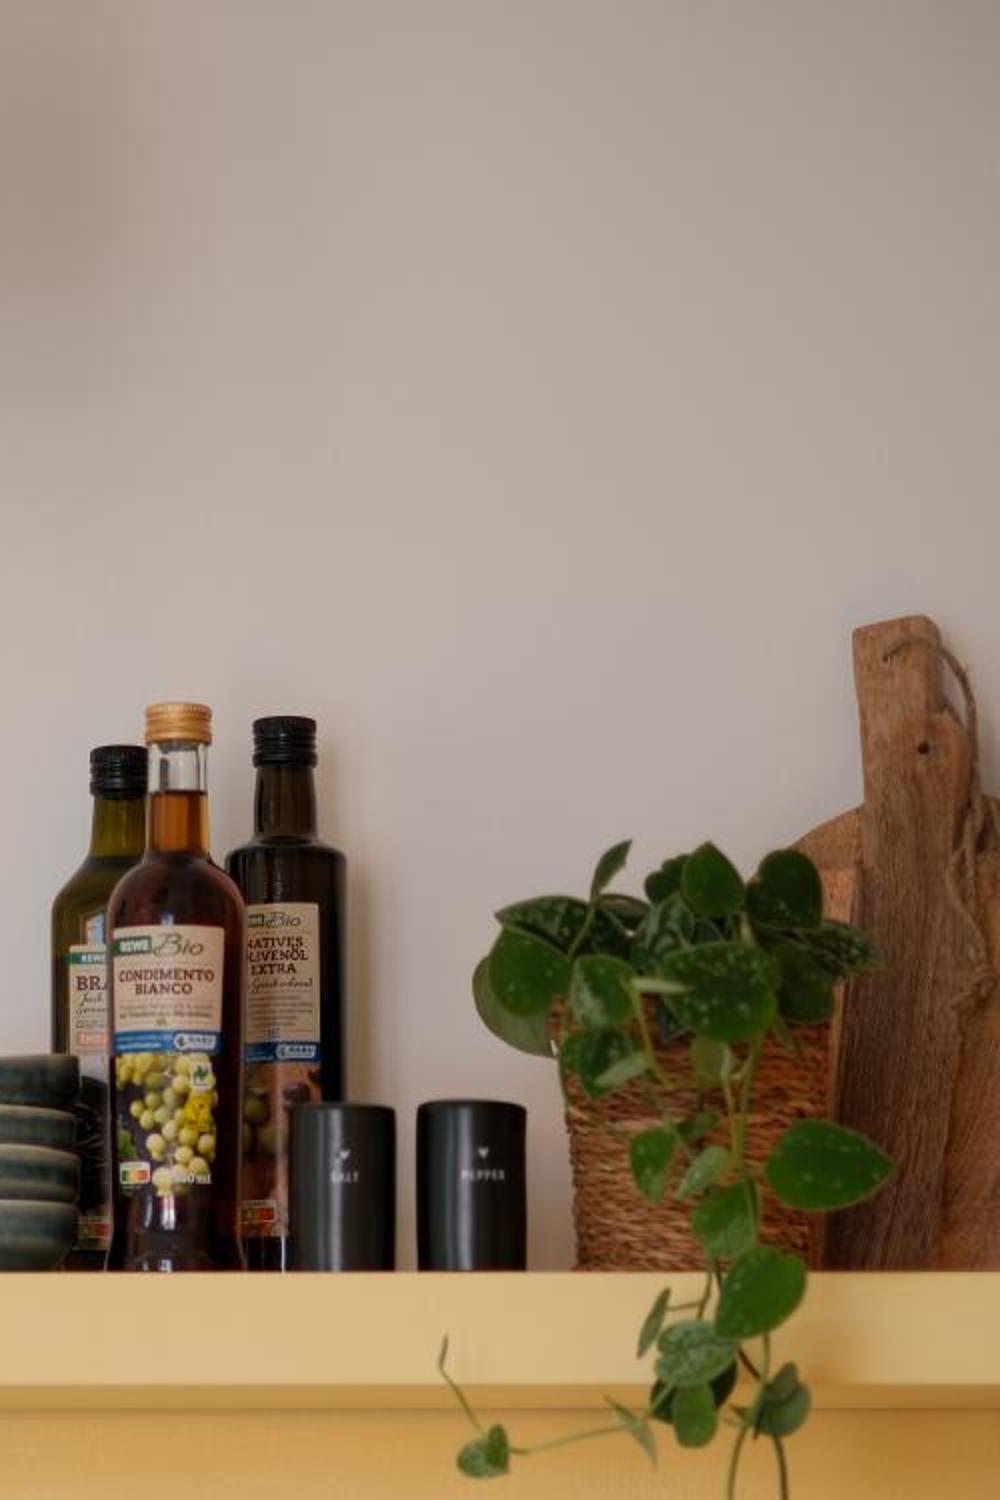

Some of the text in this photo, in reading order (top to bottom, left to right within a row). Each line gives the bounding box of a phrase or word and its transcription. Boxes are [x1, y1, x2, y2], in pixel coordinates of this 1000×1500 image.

[153, 933, 204, 957] Bio
[247, 947, 309, 963] LIVENÖL
[118, 968, 215, 983] CONDIMENTO
[250, 963, 297, 975] EXTRA
[135, 983, 193, 995] BIANCO
